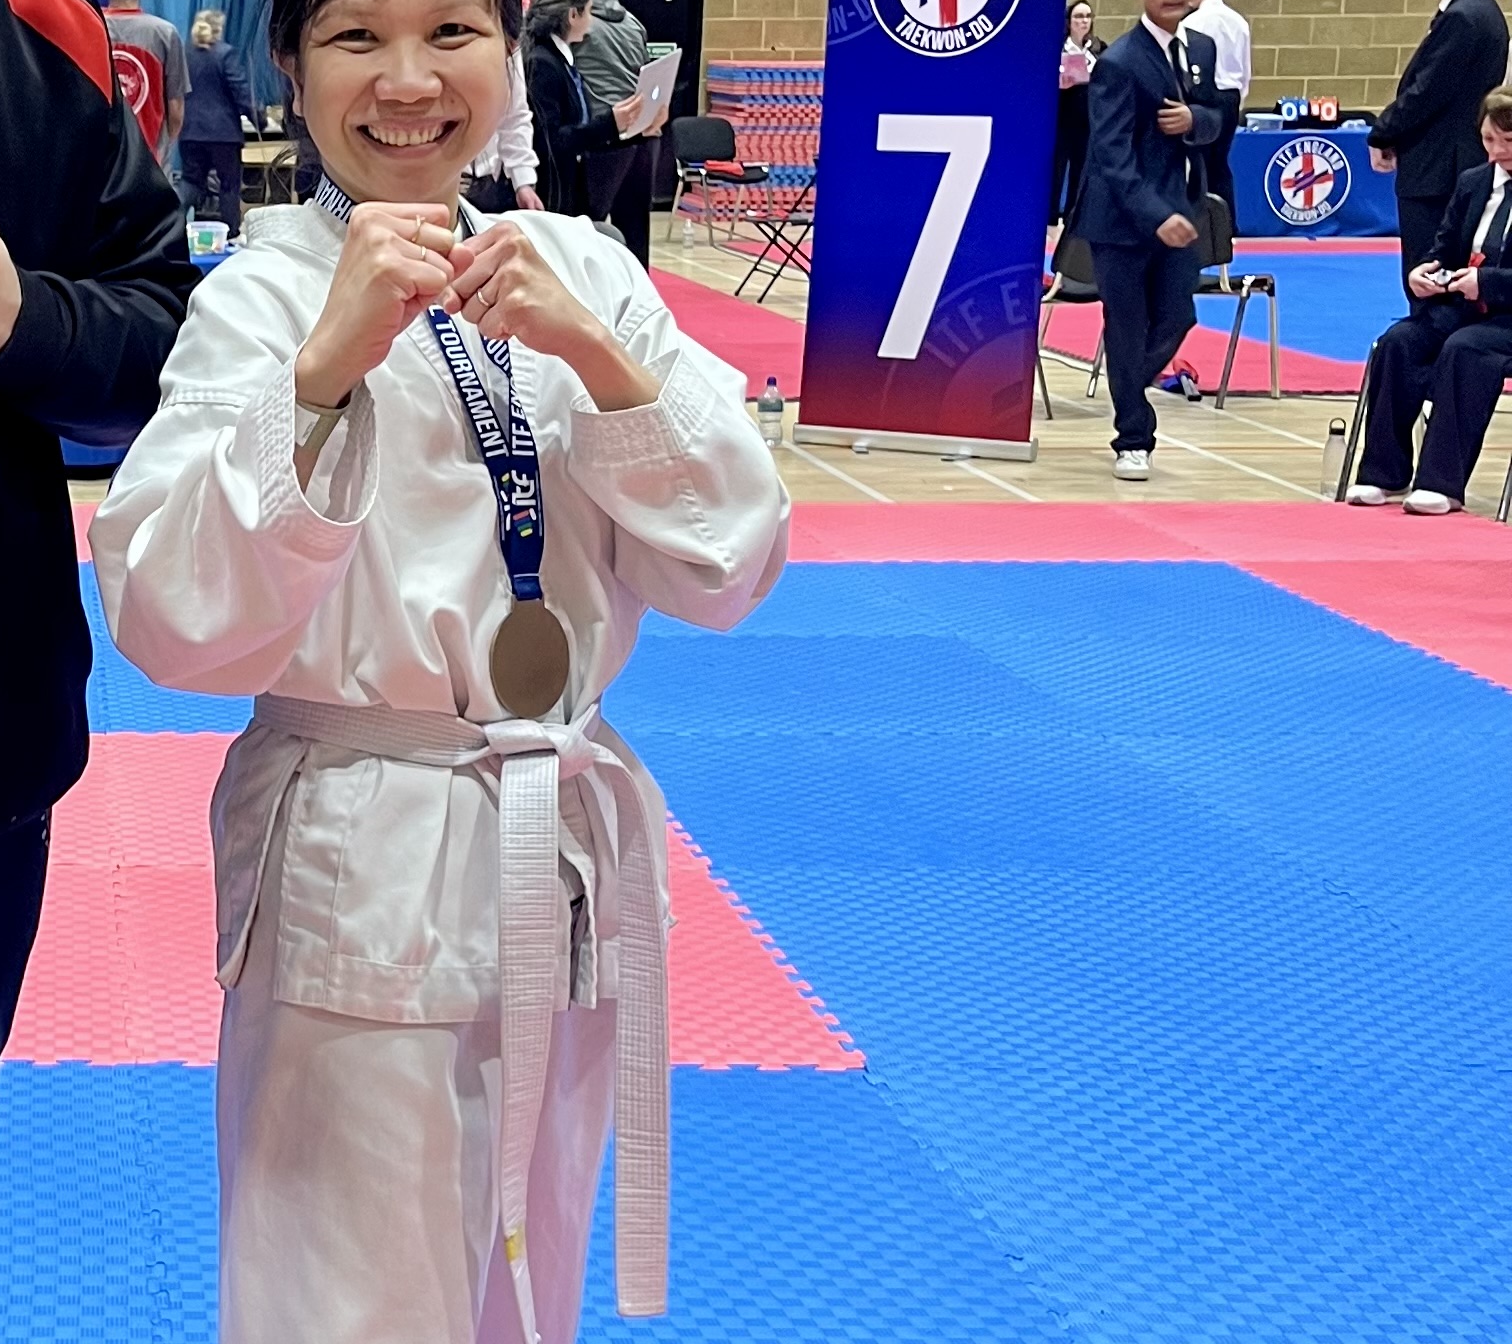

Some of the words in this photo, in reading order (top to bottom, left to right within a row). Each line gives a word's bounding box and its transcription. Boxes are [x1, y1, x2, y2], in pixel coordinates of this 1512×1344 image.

[894, 13, 994, 52] TAEKWON-DO
[876, 113, 993, 361] 7
[436, 320, 510, 457] TOURNAMENT
[512, 422, 535, 457] ITF
